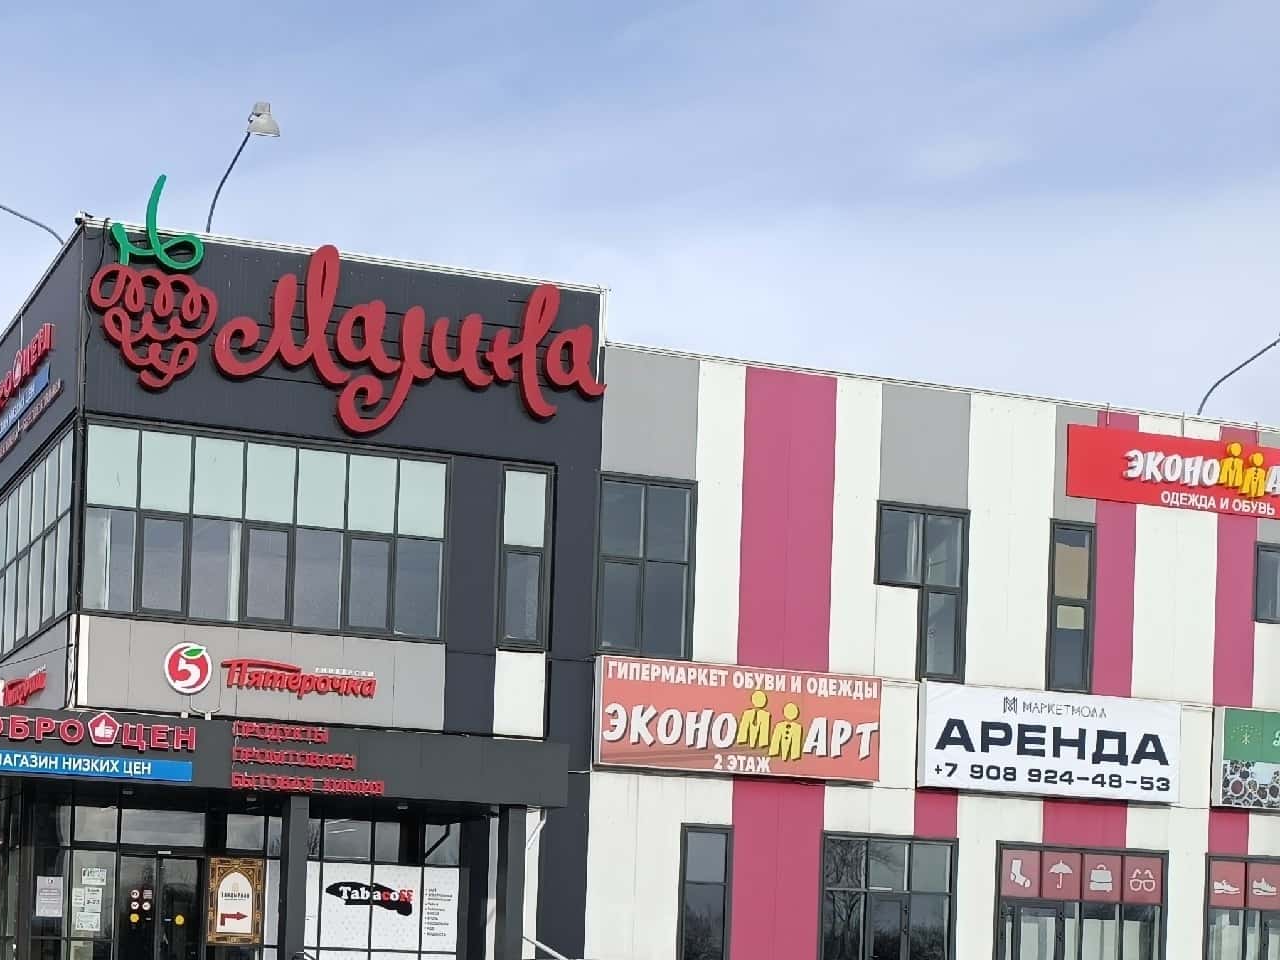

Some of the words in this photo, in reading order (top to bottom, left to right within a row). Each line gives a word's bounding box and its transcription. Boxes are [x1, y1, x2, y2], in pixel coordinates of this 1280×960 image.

[213, 244, 606, 433] Малина
[1161, 491, 1217, 509] ОДЕЖДА
[1220, 497, 1228, 508] И
[1232, 498, 1276, 516] ОБУВЬ
[608, 661, 729, 688] ГИПЕРМАРКЕТ
[732, 671, 786, 693] ОБУВИ
[791, 675, 802, 694] И
[806, 678, 879, 700] ОДЕЖДЫ
[232, 720, 329, 744] ПРОДУКТЫ
[934, 718, 1169, 767] АРЕНДА
[62, 755, 120, 773] НИЗКИХ
[123, 760, 152, 776] ЦЕН
[231, 746, 357, 770] ПРОМТОВАРЫ
[713, 754, 723, 770] 2
[726, 755, 771, 772] ЭТАЖ
[231, 771, 313, 791] БЫТОВАЯ
[322, 777, 385, 796] ХИМИЯ
[934, 763, 958, 777] +7
[969, 764, 1017, 781] 908
[1027, 768, 1171, 792] 924-48-53
[339, 886, 414, 903] Tabacoff
